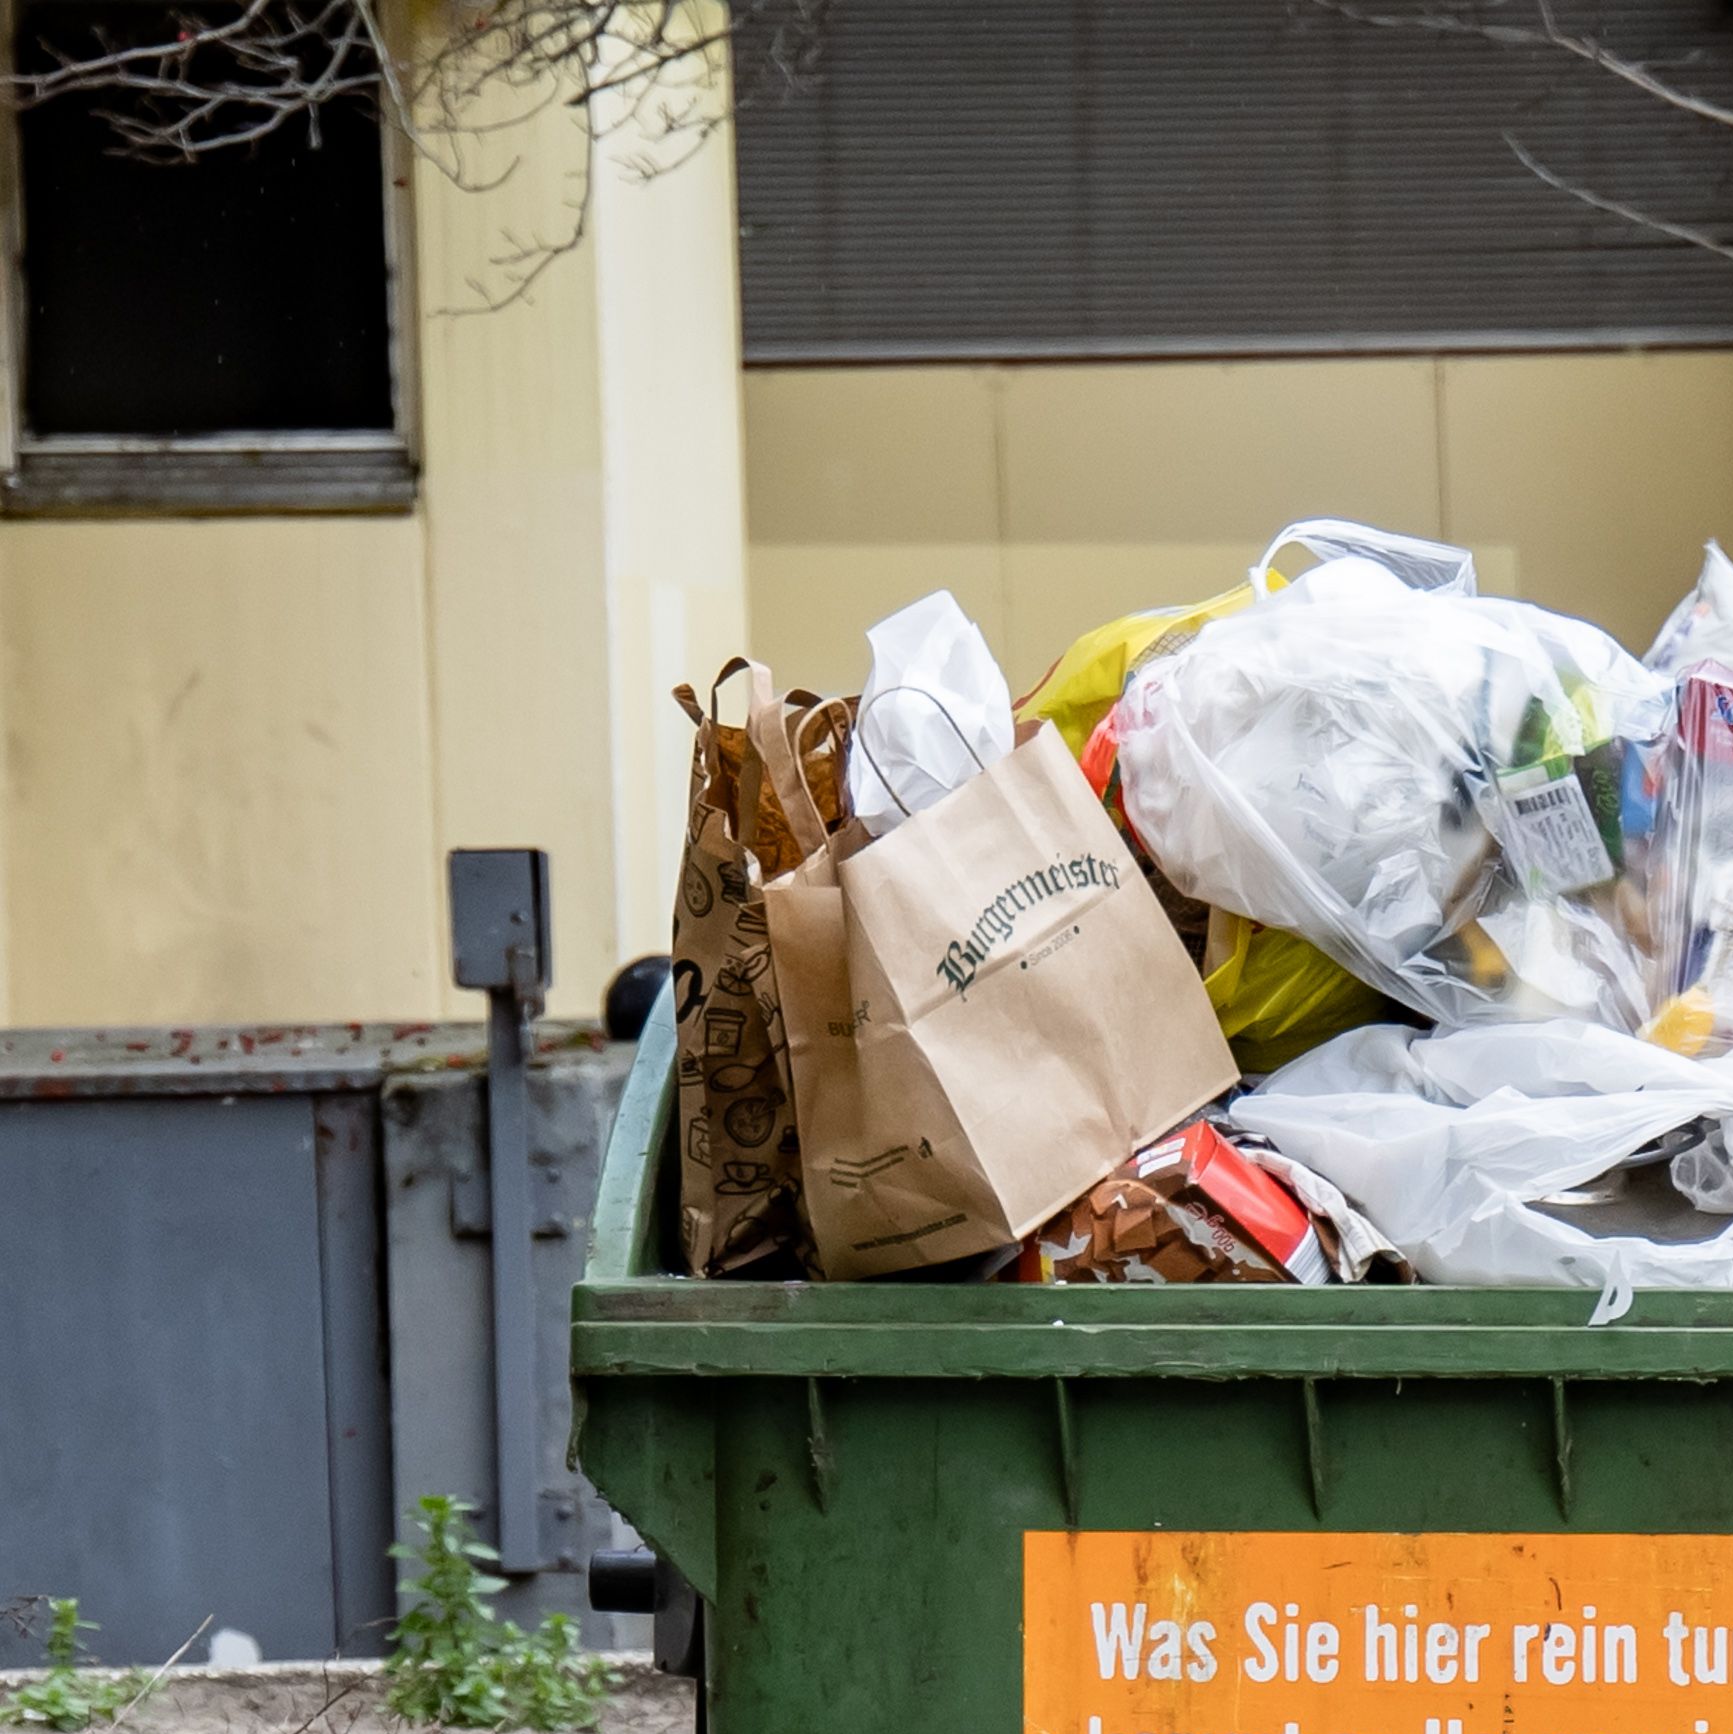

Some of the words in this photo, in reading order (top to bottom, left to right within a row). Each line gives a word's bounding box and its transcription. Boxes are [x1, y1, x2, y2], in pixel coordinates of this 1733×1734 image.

[936, 852, 1120, 1003] Burgermeister
[1090, 1602, 1218, 1684] Was
[1244, 1601, 1340, 1684] Sie
[1364, 1603, 1491, 1685] hier
[1513, 1605, 1638, 1686] rein
